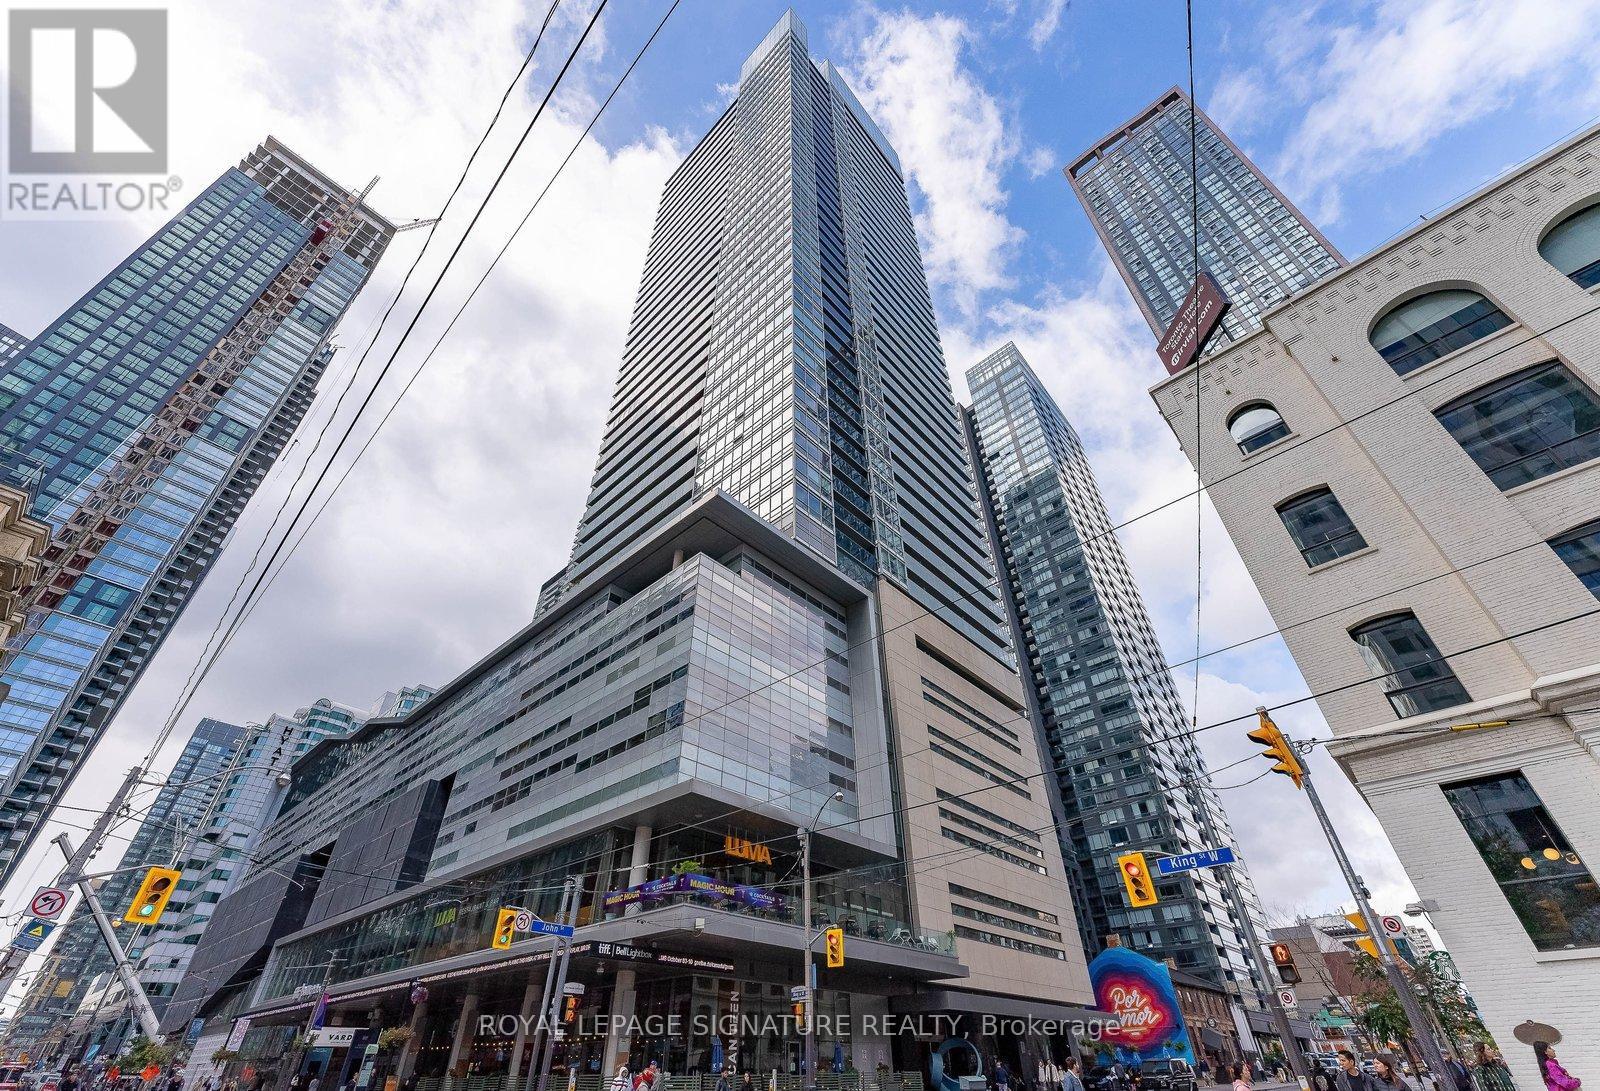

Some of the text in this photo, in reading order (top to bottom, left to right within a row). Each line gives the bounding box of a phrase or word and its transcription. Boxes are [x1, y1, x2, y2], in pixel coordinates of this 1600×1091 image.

[1162, 321, 1183, 353] Toronto
[1171, 323, 1188, 350] Starts
[725, 836, 773, 866] LUMA
[1170, 856, 1198, 868] King
[1208, 850, 1219, 862] W
[690, 879, 714, 891] MAGIC
[715, 884, 735, 896] HOUR
[542, 923, 558, 933] John
[1110, 987, 1147, 1009] Por
